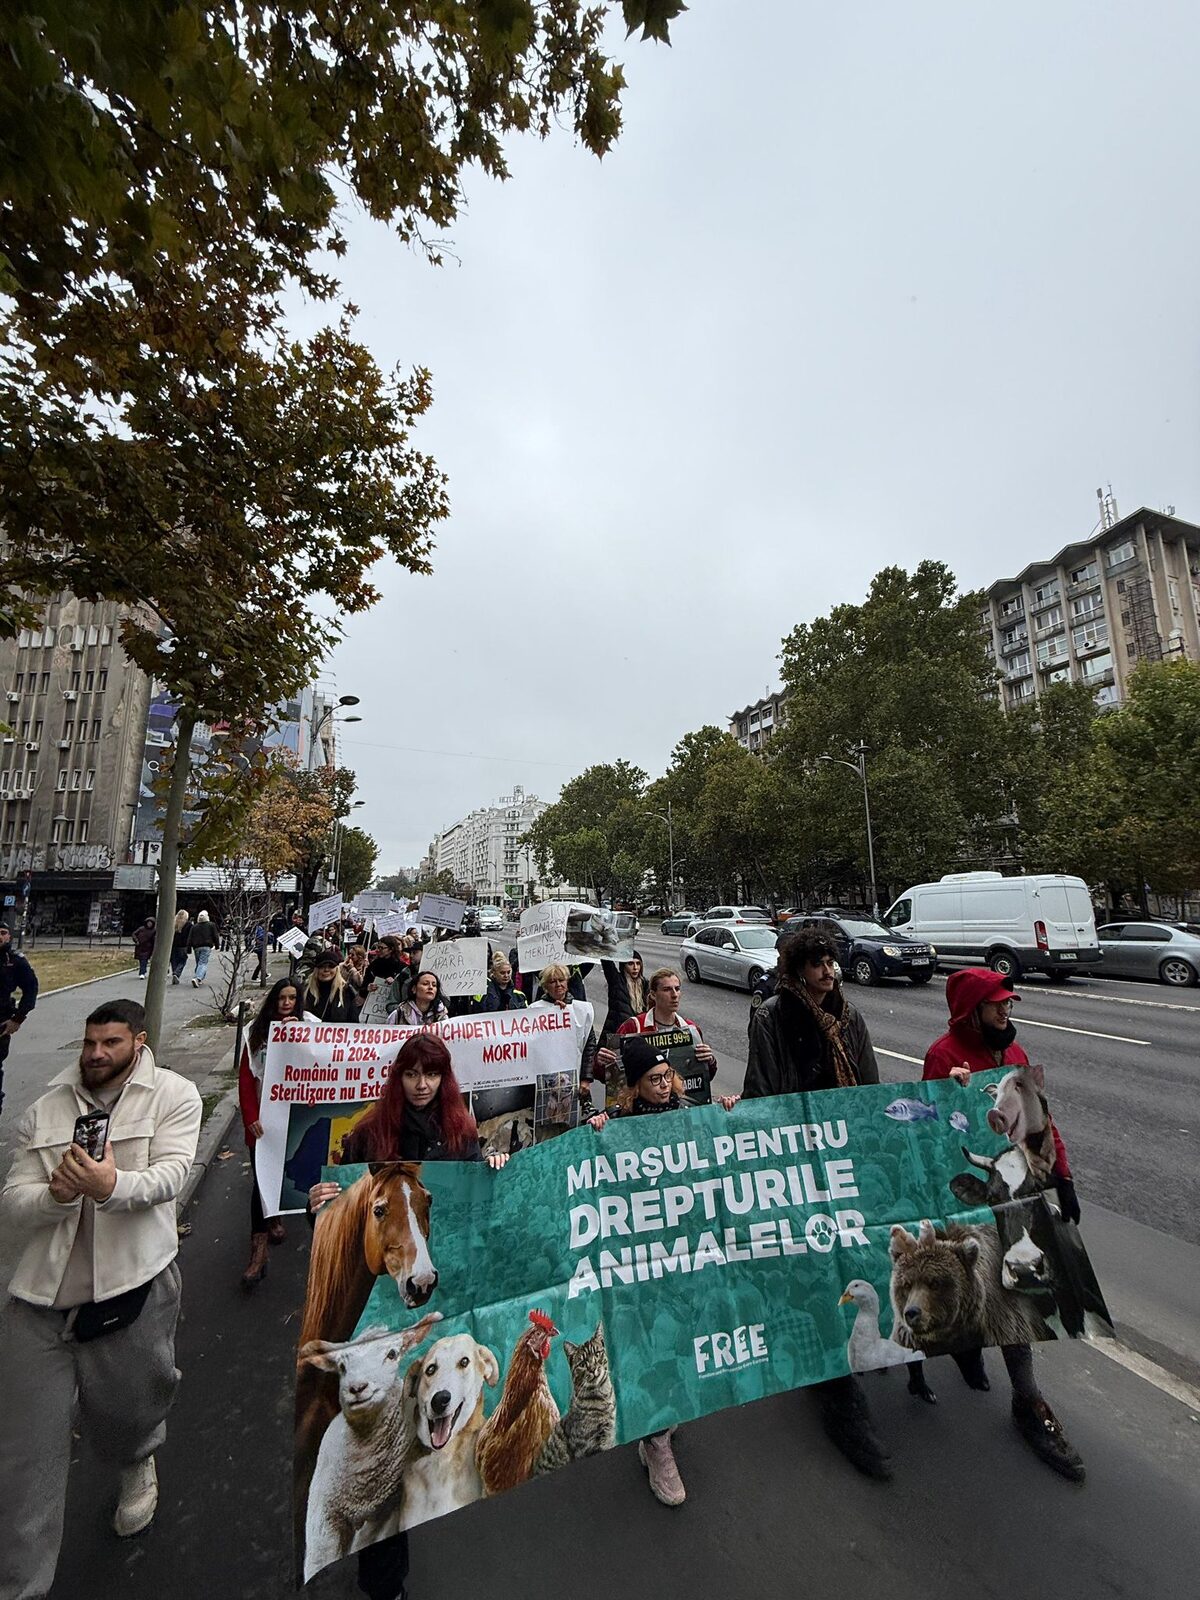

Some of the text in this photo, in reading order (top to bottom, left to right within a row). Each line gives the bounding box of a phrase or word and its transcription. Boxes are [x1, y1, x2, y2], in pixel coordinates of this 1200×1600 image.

[353, 1029, 381, 1044] 9186
[331, 1044, 381, 1062] in 2024.
[483, 1041, 527, 1064] MORTII
[284, 1062, 339, 1081] România
[346, 1066, 361, 1080] nu
[367, 1066, 375, 1079] e
[270, 1082, 336, 1108] Sterilizare
[340, 1086, 356, 1100] nu
[713, 1119, 850, 1165] PENTRU
[569, 1158, 860, 1249] DREPTURILE
[568, 1209, 871, 1300] ANIMALELOR
[694, 1323, 768, 1373] FREE
